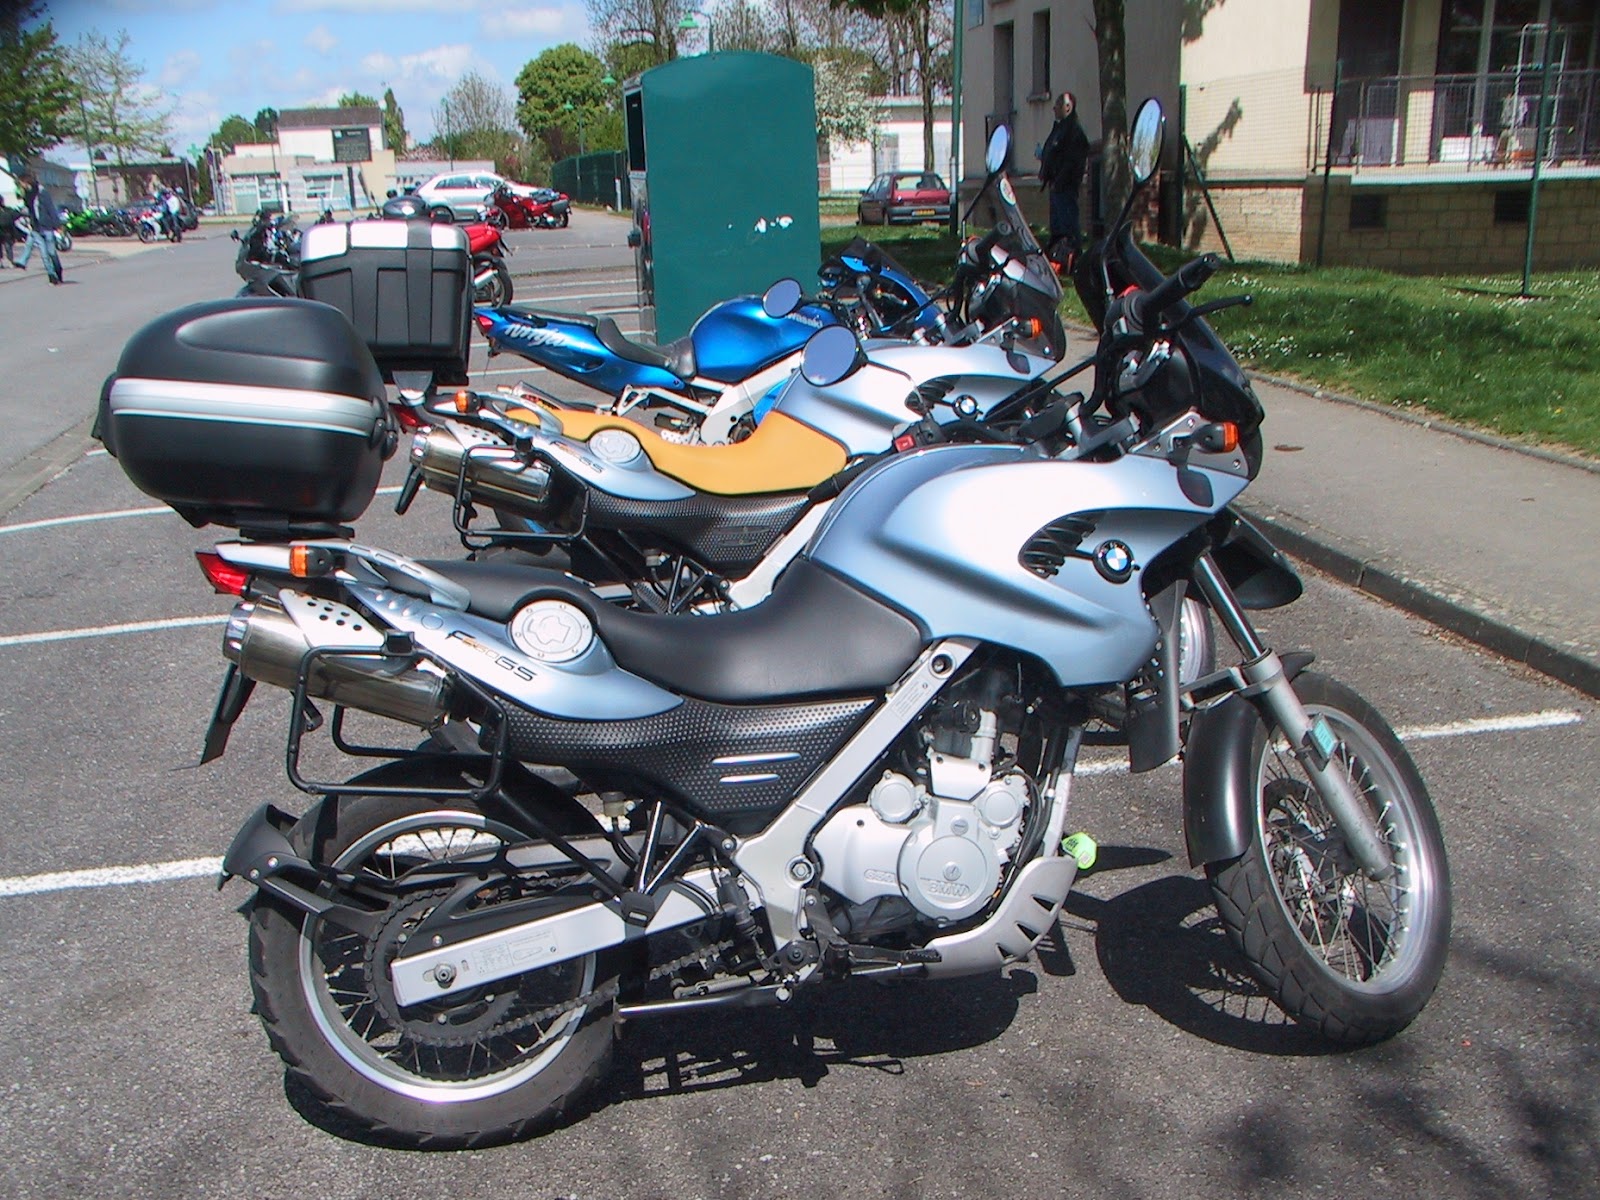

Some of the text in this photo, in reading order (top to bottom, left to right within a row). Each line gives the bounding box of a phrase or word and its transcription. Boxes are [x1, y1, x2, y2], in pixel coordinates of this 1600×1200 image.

[786, 312, 823, 329] wasaki
[504, 323, 567, 347] Ninja
[929, 880, 968, 898] BMW
